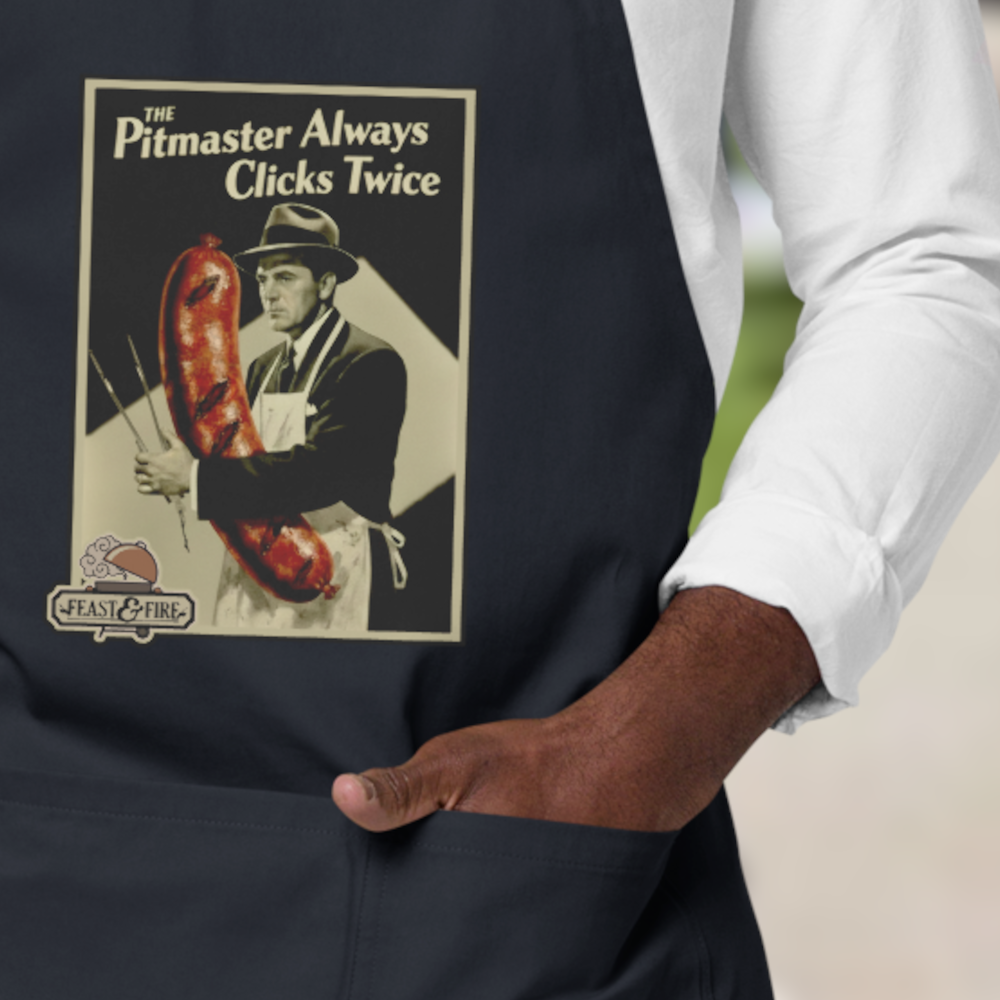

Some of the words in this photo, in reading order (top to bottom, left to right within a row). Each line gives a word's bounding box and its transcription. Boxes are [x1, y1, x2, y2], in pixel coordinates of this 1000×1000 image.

[143, 106, 176, 122] THE
[113, 117, 293, 159] Pitmaster
[300, 108, 429, 153] Always
[225, 159, 333, 200] Clicks
[343, 155, 441, 195] Twice
[66, 599, 118, 617] FEAST
[145, 601, 180, 619] FIRE
